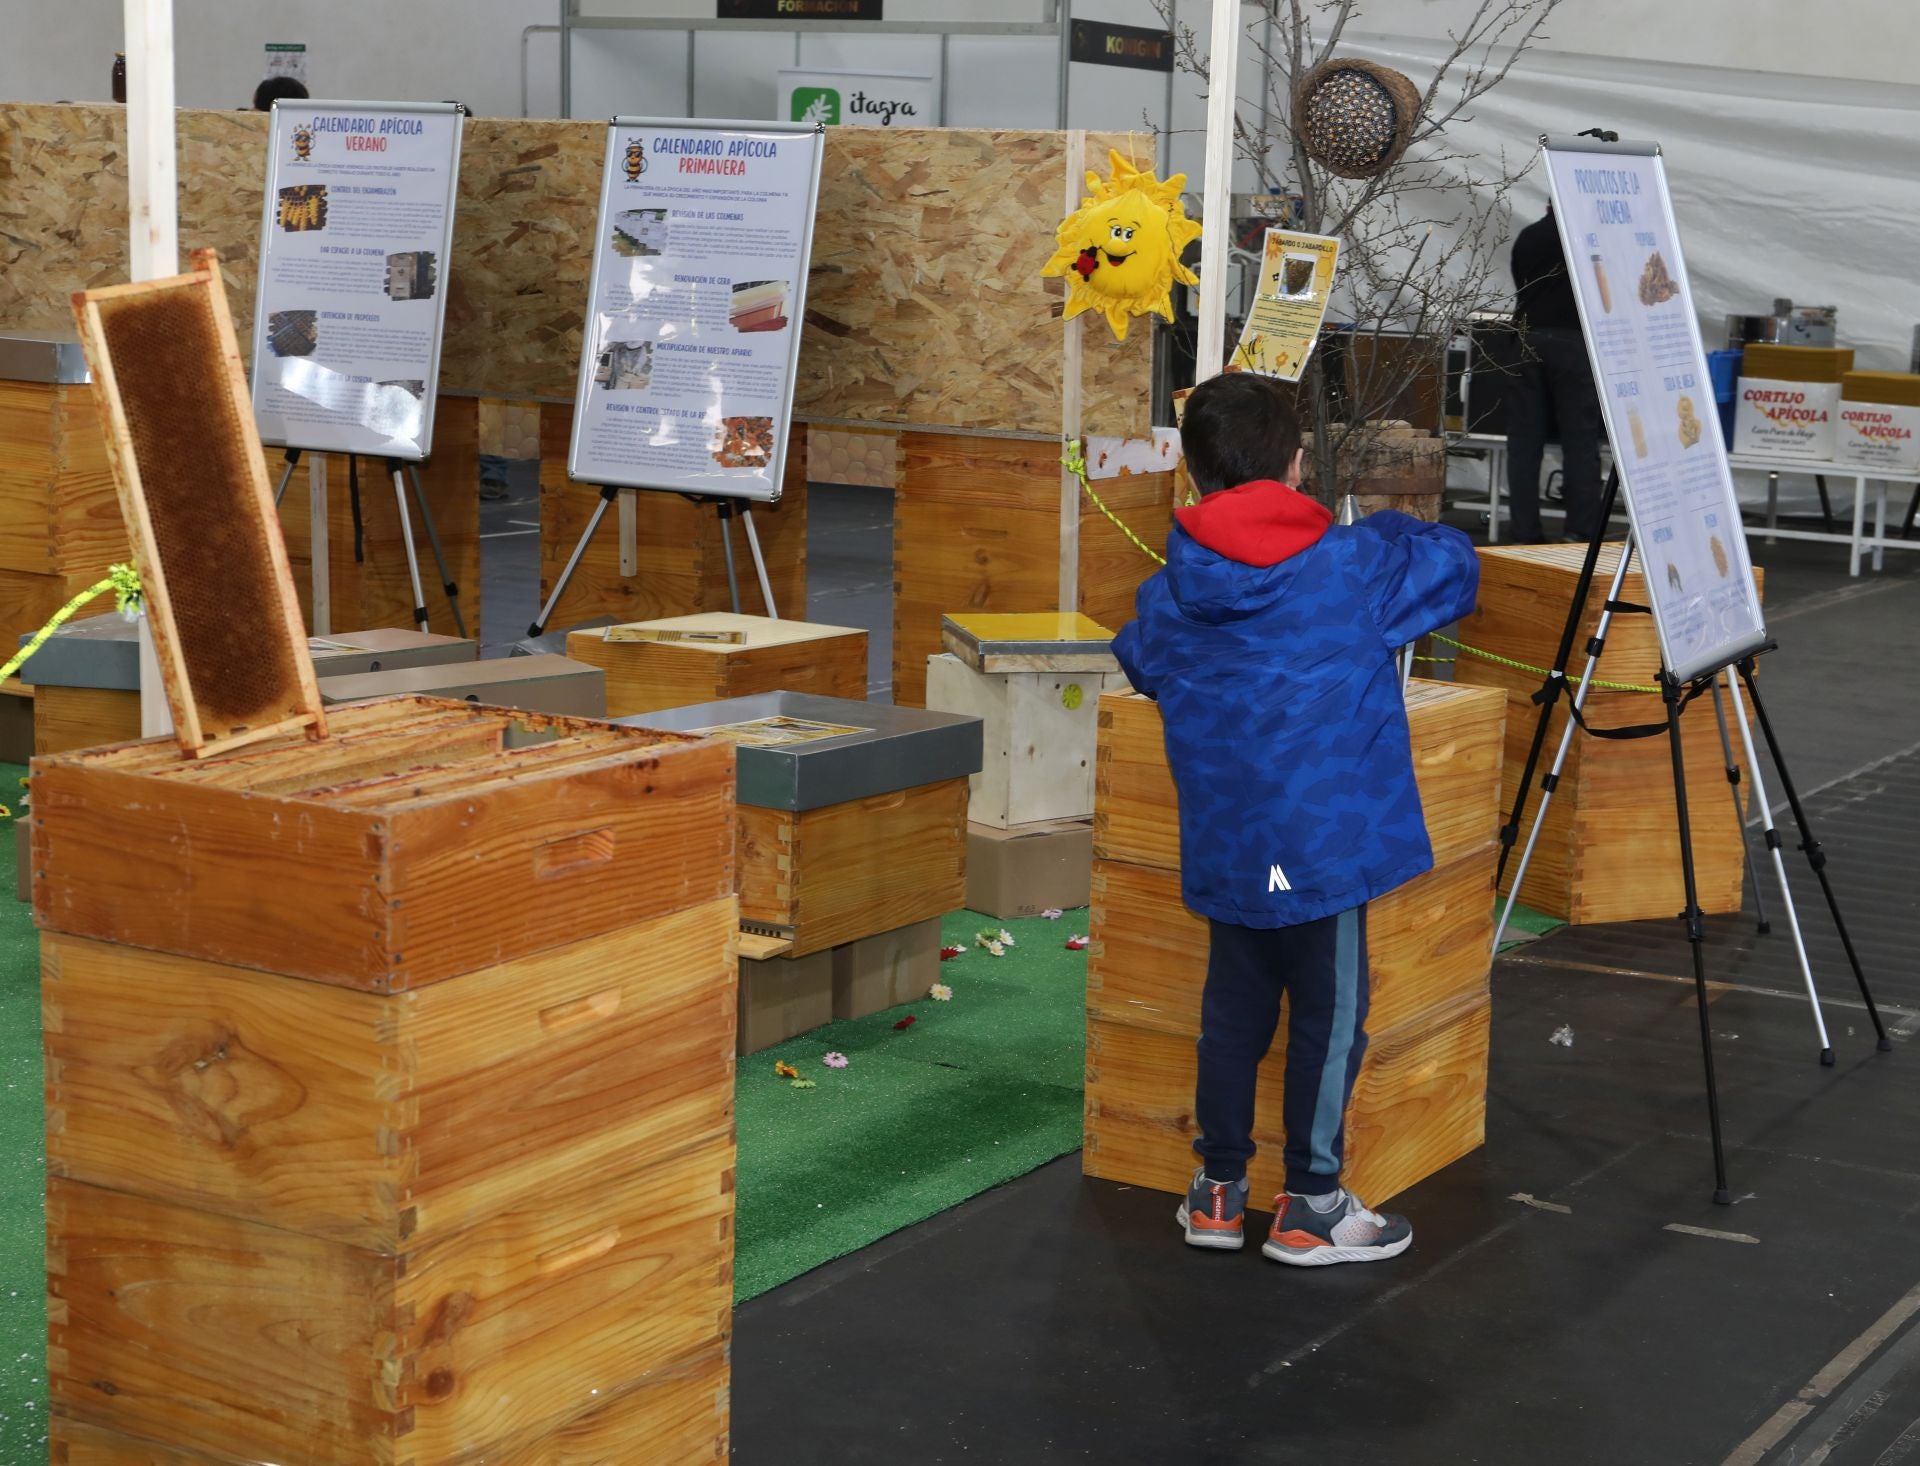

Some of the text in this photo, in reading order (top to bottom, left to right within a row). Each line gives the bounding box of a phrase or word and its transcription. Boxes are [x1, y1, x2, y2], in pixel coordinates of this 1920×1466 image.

[850, 91, 917, 126] itagra
[313, 116, 423, 136] CALENDARIO APÍCOLA
[345, 136, 388, 152] VERANO
[653, 137, 777, 158] CALENDARIO APÍCOLA
[1743, 389, 1805, 405] CORTIJO
[1766, 406, 1829, 423] APÍCOLA
[1841, 410, 1893, 424] CORTIJO
[1860, 425, 1912, 440] APÍCOLA
